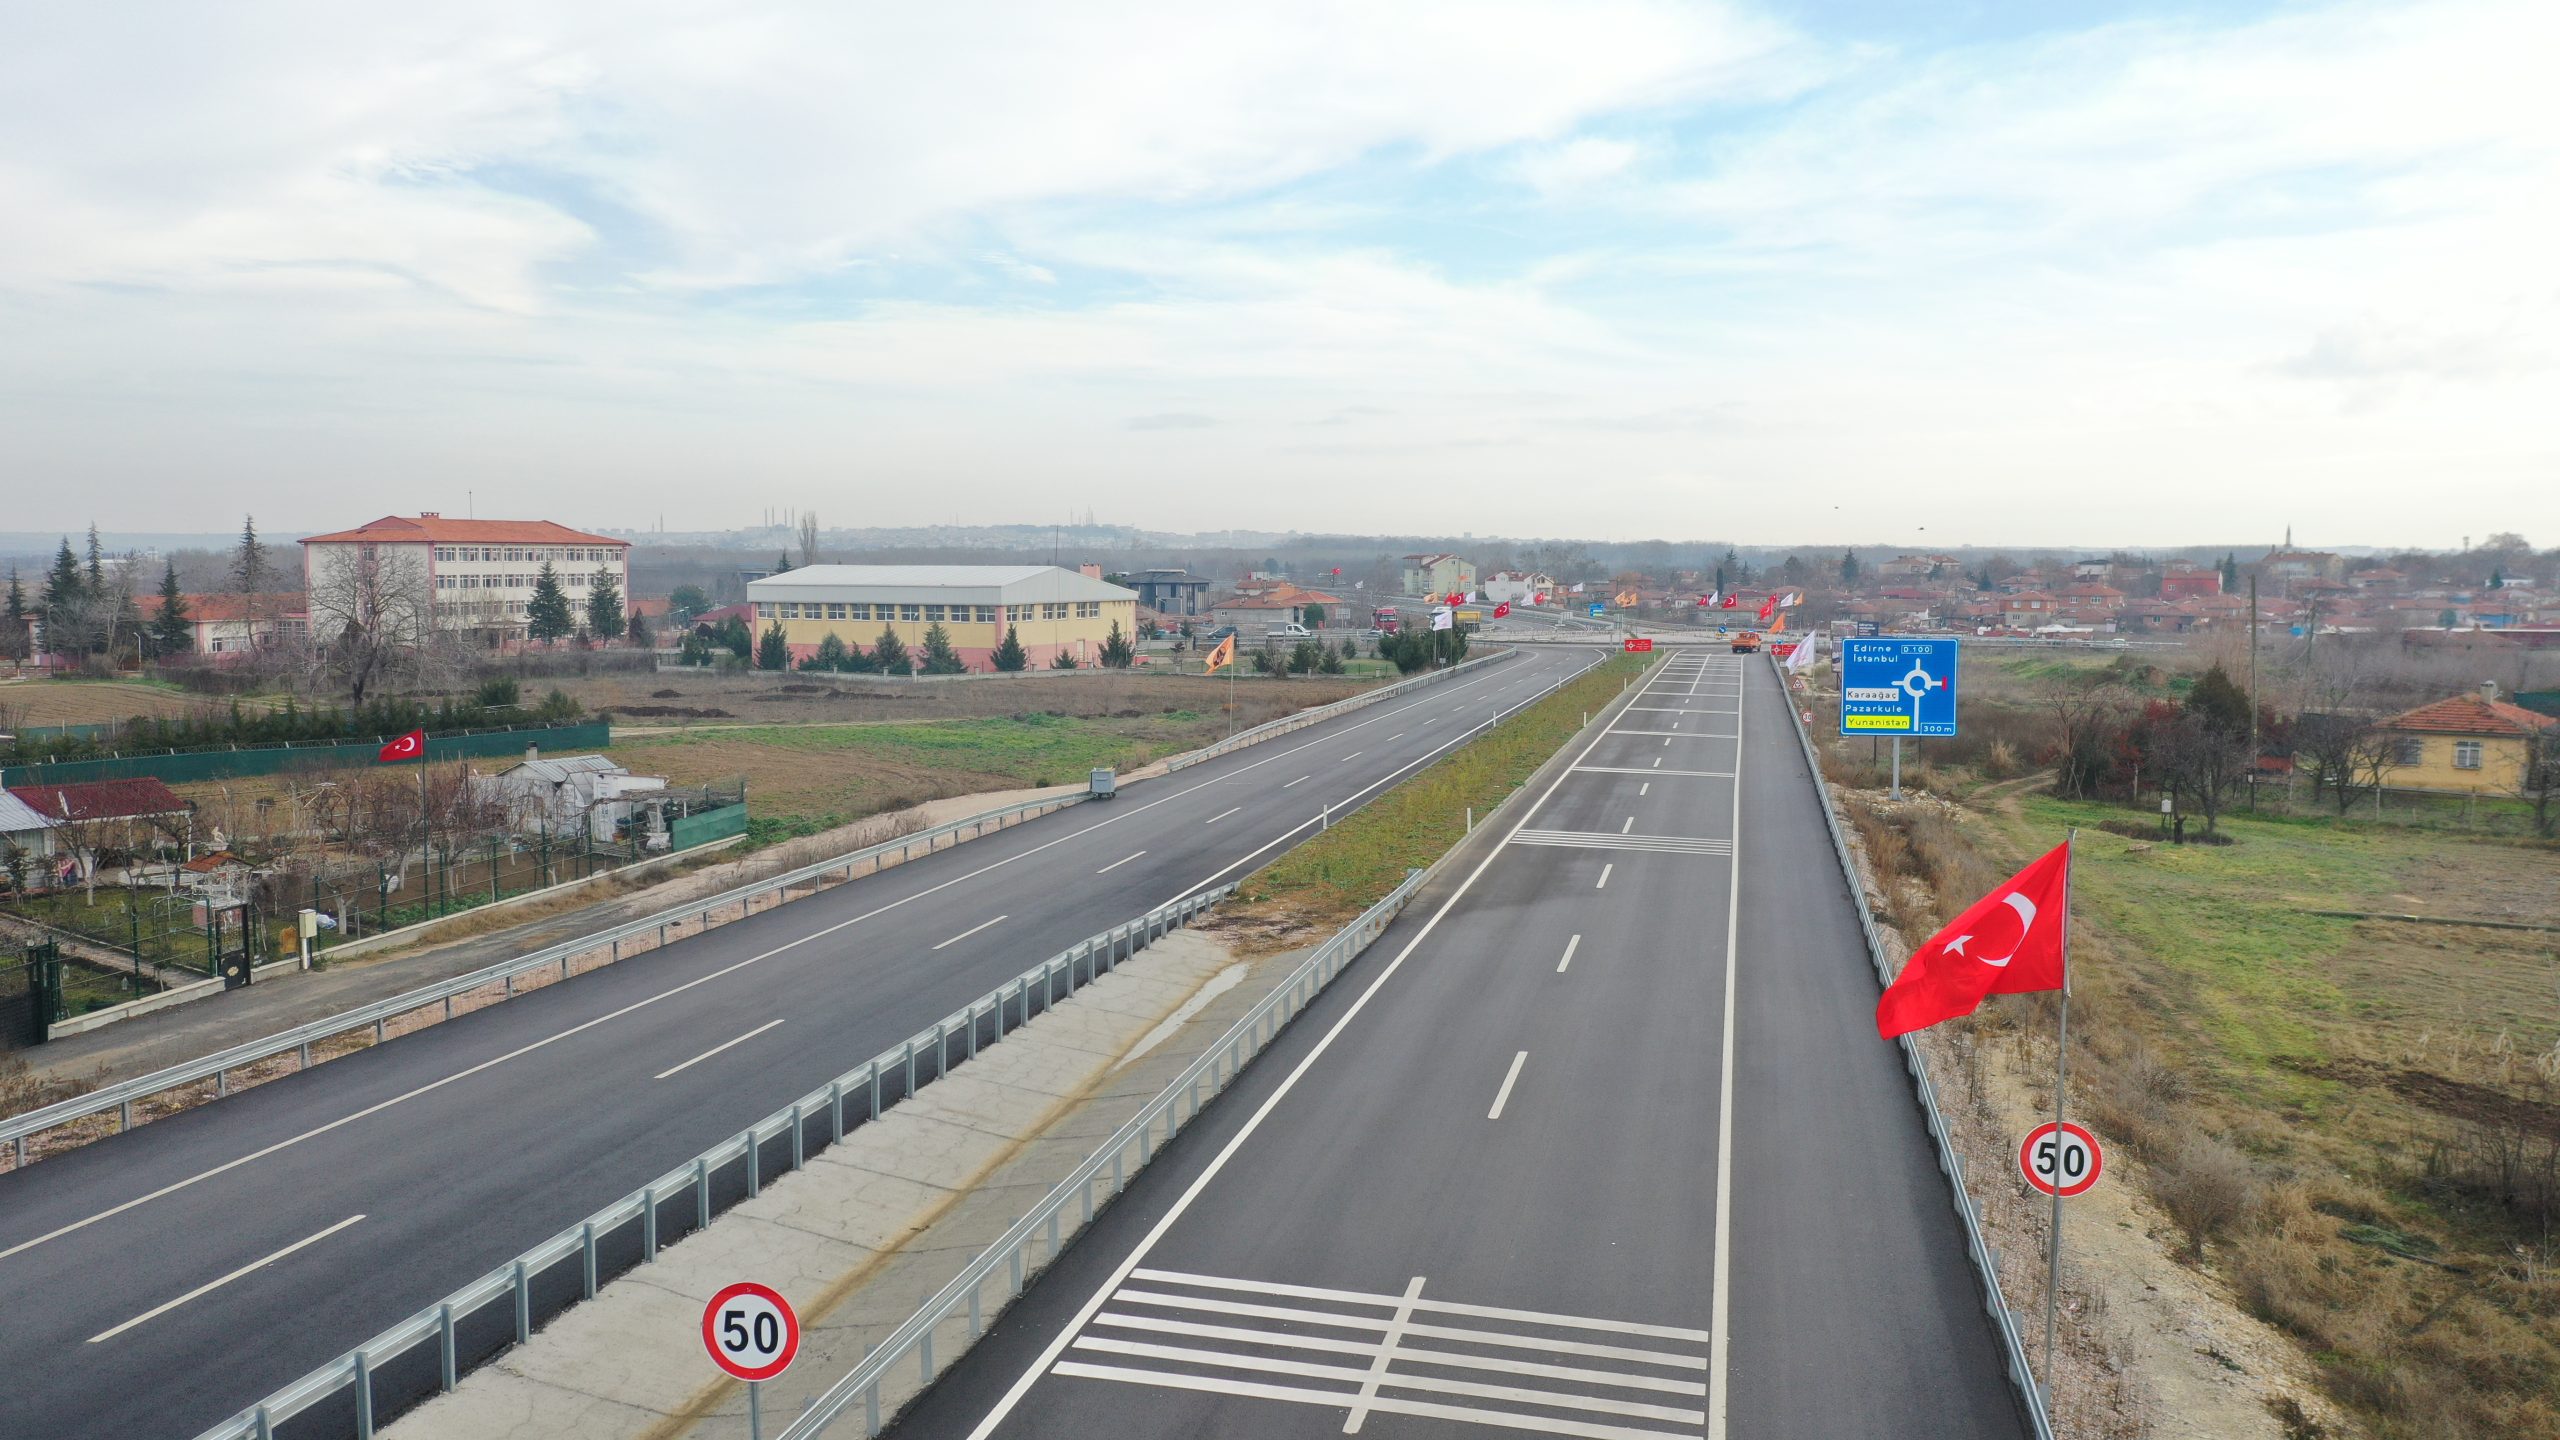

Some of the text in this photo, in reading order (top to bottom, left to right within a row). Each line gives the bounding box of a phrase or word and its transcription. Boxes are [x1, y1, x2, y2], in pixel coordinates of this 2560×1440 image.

[1853, 644, 1892, 652] Edirne
[1853, 653, 1898, 663] İstanbul
[1847, 690, 1897, 700] Karaağaç
[1845, 704, 1903, 713] Pazarkule
[1848, 718, 1908, 727] Yunanistan
[2036, 1142, 2085, 1177] 50
[723, 1310, 779, 1354] 50
